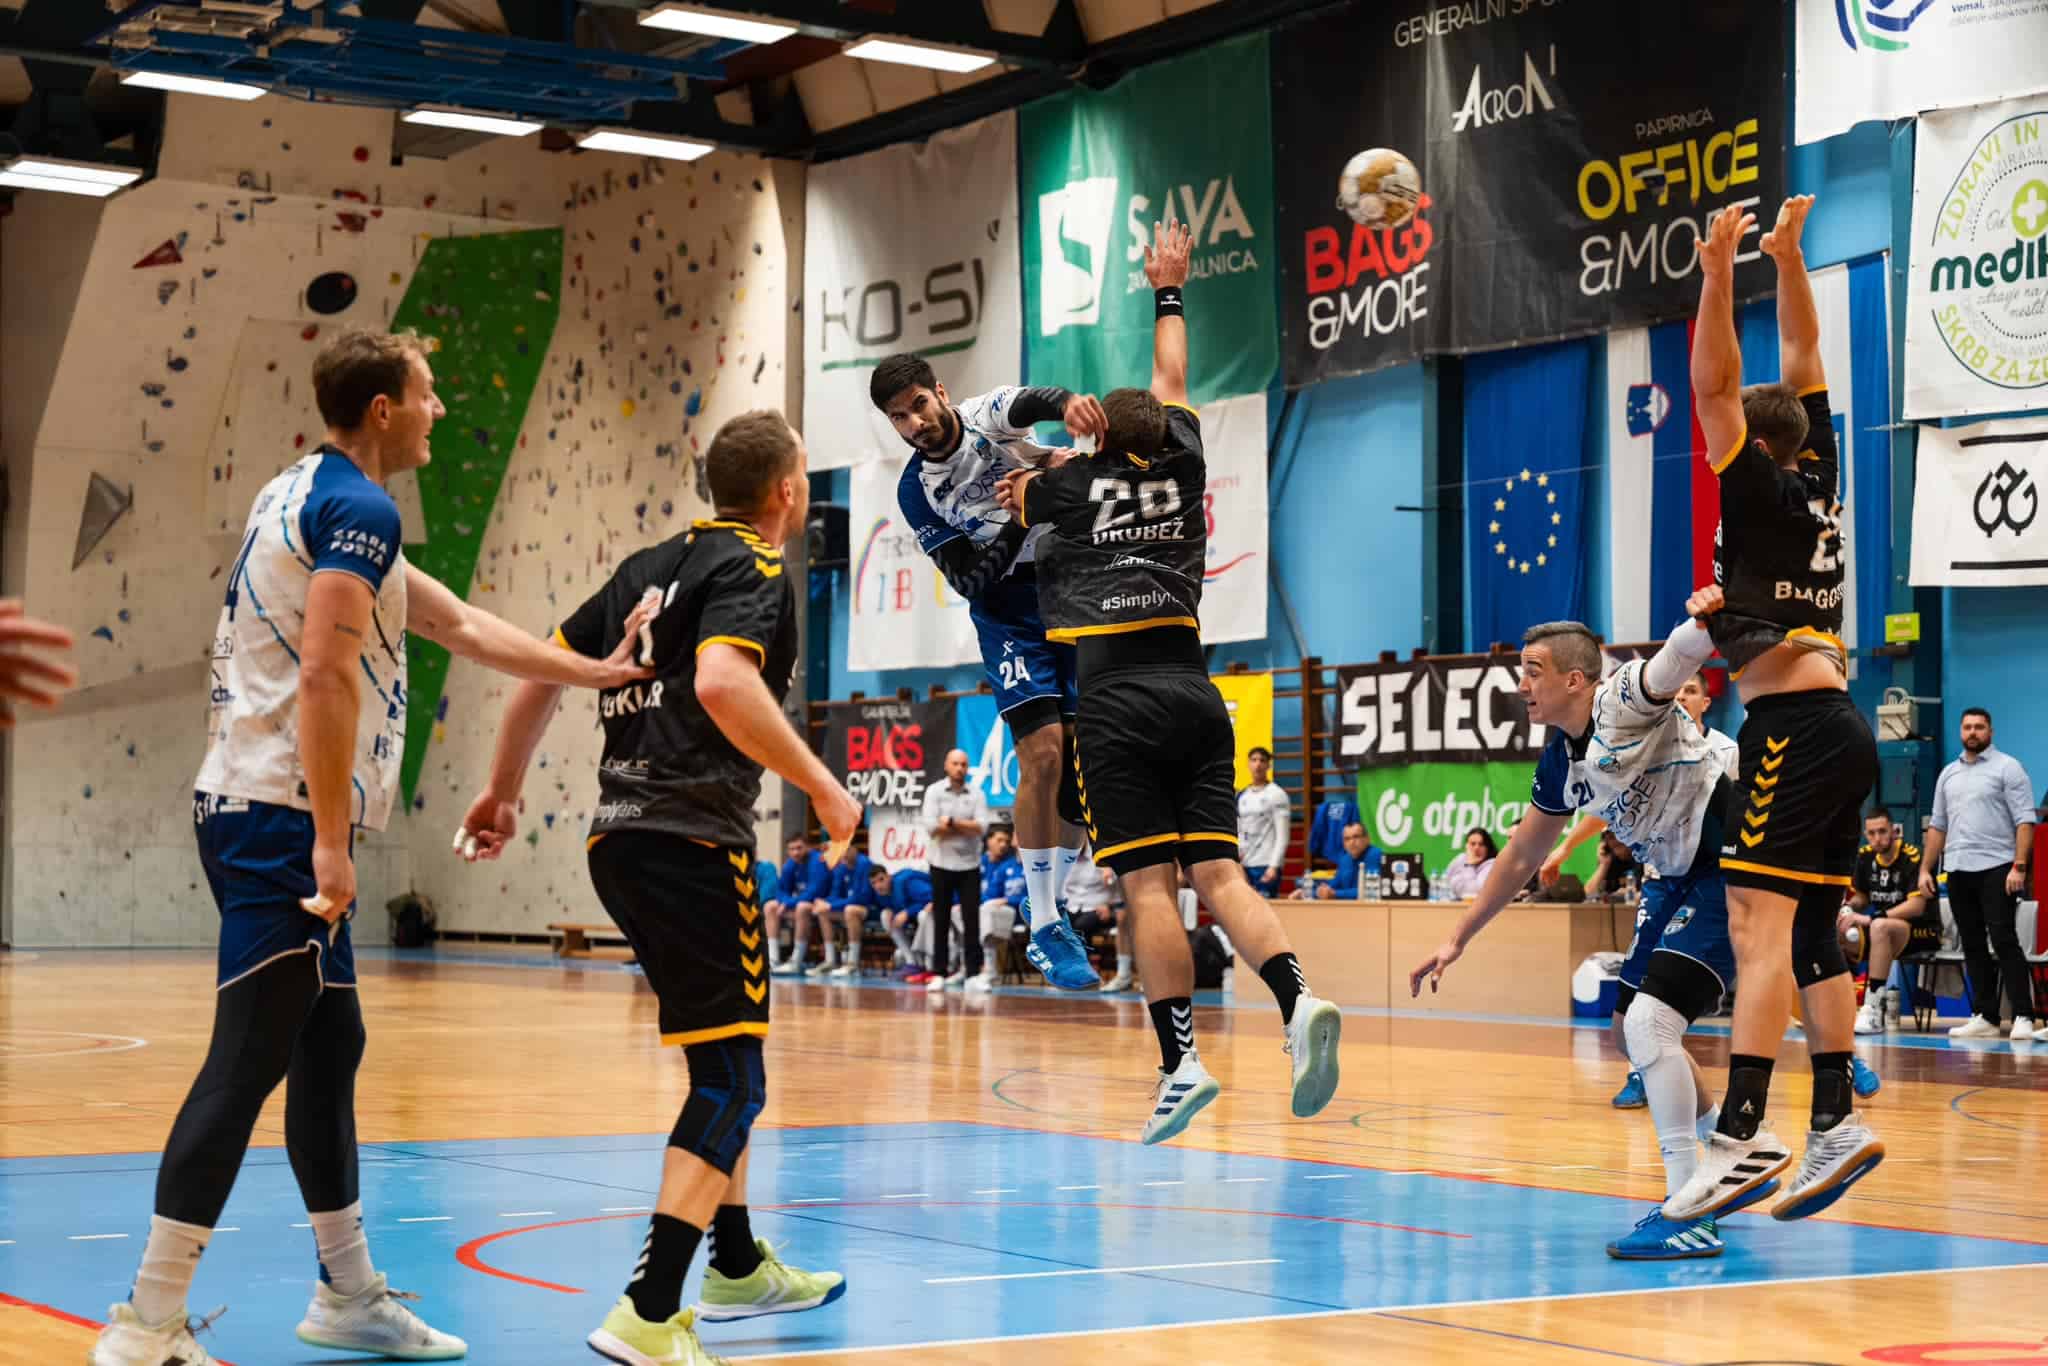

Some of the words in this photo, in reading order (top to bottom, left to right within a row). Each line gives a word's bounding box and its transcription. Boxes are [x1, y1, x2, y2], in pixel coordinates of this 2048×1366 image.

[1394, 0, 1506, 47] GENERALNI
[1635, 108, 1713, 140] PAPIRNICA
[1577, 118, 1759, 220] OFFICE
[1938, 133, 2001, 241] ZDRAVI
[2014, 119, 2040, 145] IN
[1126, 175, 1255, 263] SAVA
[1305, 192, 1433, 294] BAGS
[1308, 261, 1431, 349] &MORE
[1938, 304, 1990, 369] SKRB
[1000, 656, 1031, 691] 24
[847, 723, 924, 771] BAGS
[847, 769, 927, 806] &MORE
